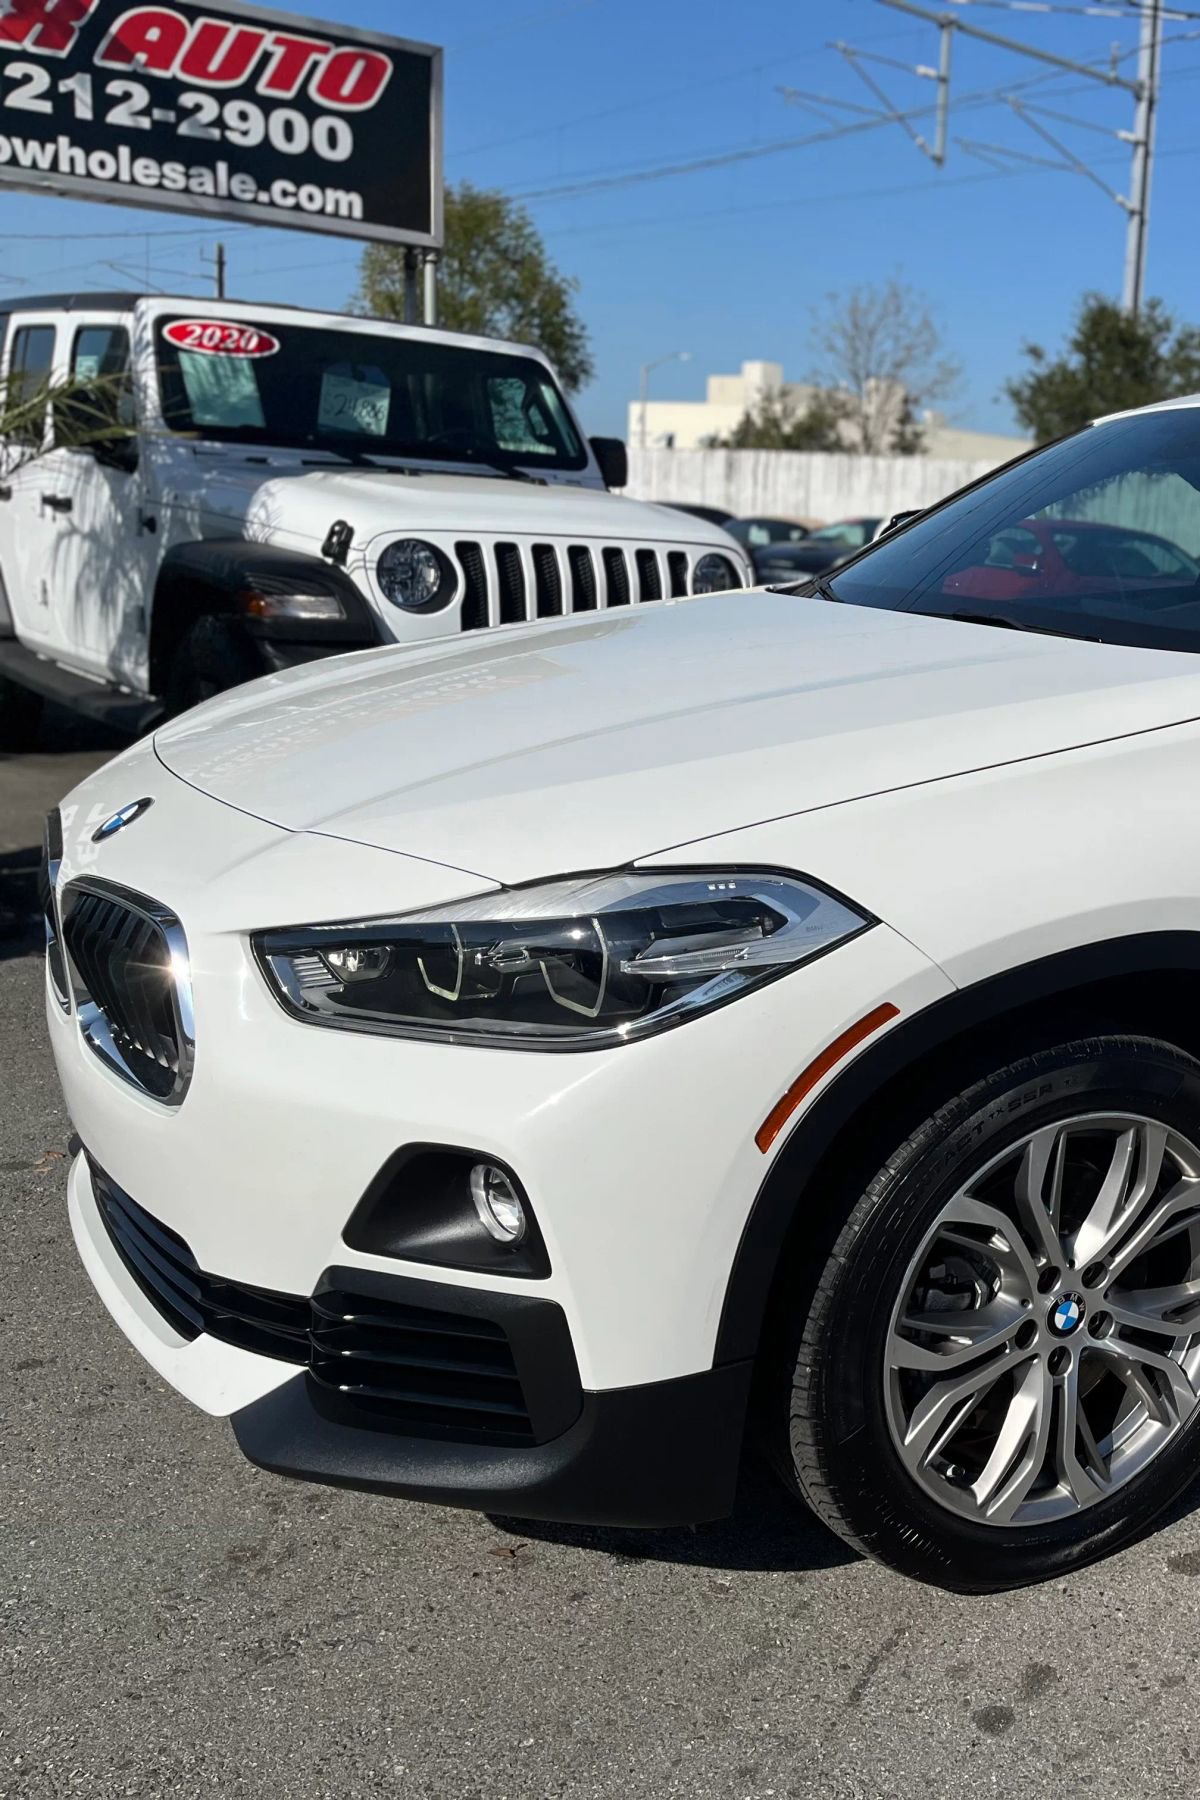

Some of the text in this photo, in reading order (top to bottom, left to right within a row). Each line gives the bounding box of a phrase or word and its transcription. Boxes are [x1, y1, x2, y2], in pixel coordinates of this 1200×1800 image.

[93, 6, 393, 112] AUTO
[3, 61, 353, 162] 212-2900
[183, 324, 259, 350] 2020
